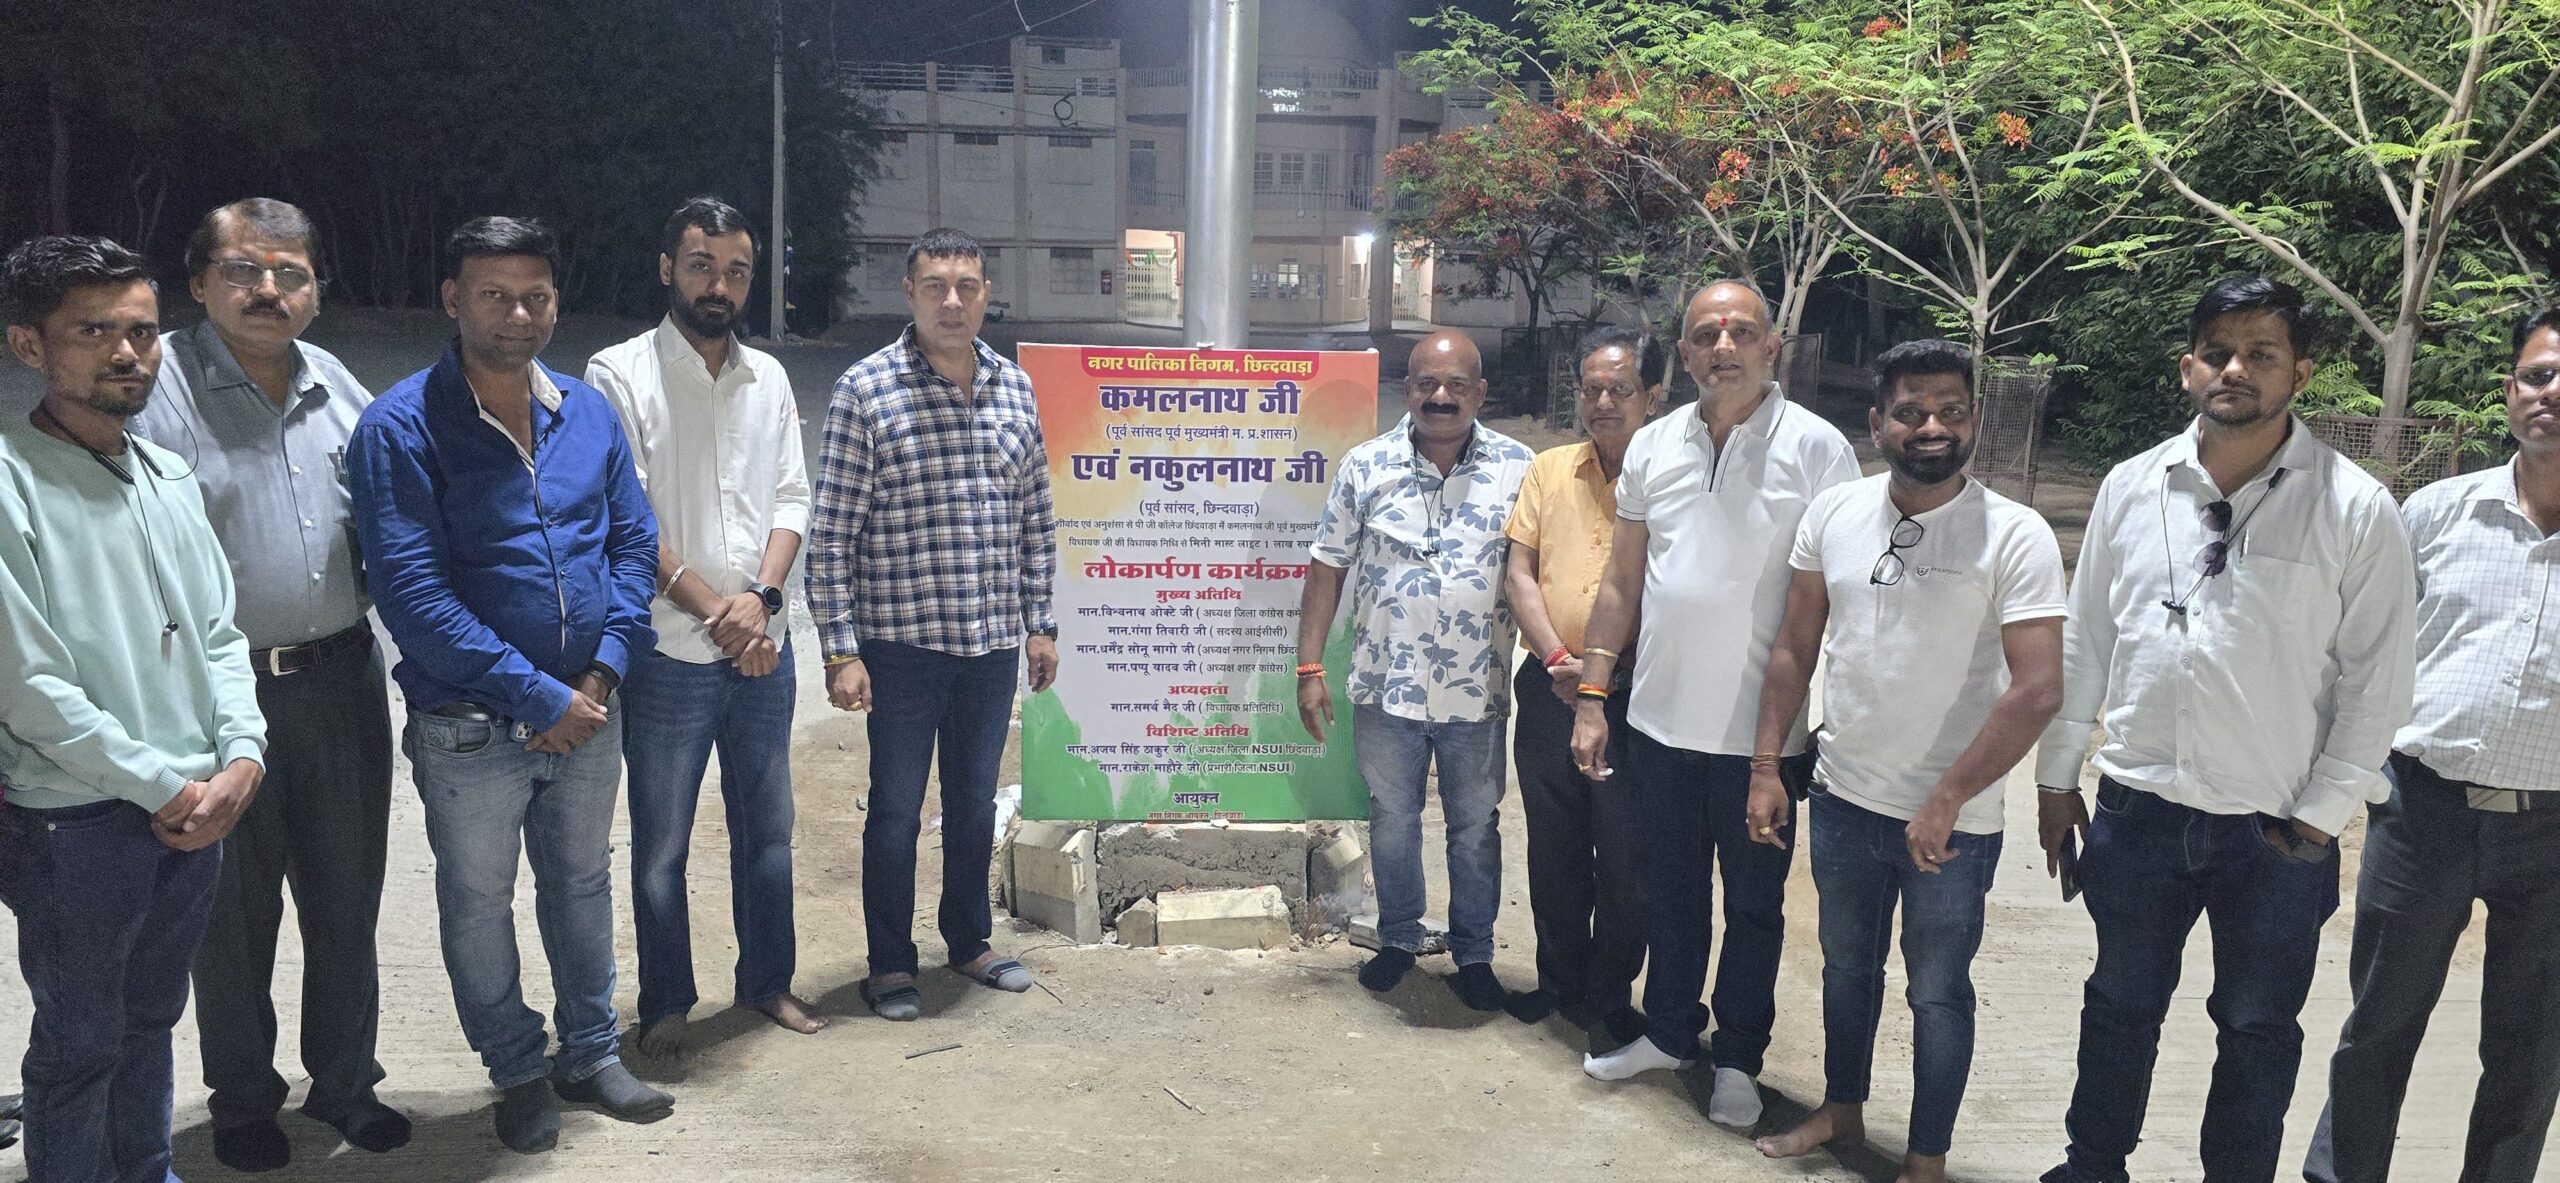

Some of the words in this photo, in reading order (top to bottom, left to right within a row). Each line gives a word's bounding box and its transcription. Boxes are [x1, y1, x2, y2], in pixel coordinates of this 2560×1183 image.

[1088, 356, 1123, 370] नगर
[1127, 353, 1186, 371] पालिका
[1190, 353, 1240, 374] निगम,
[1244, 354, 1312, 376] छिन्दवाड़ा
[1100, 386, 1249, 413] कमलनाथ
[1258, 380, 1301, 414] जी
[1106, 425, 1126, 441] (पूर्व
[1131, 425, 1161, 438] सांसद
[1166, 426, 1181, 441] पूर्व
[1185, 426, 1229, 441] मुख्यमंत्री
[1232, 430, 1244, 440] म.
[1248, 427, 1298, 441] प्र.शासन)
[1071, 449, 1120, 481] एवं
[1128, 456, 1276, 492] नकुलनाथ
[1285, 451, 1328, 484] जी
[1139, 500, 1160, 515] (पूर्व
[1163, 501, 1199, 515] सांसद,
[1203, 501, 1260, 517] छिन्दवाड़ा)
[1055, 518, 1078, 528] शीर्वाद
[1081, 519, 1091, 529] एवं
[1093, 520, 1124, 531] अनुशंसा
[1126, 520, 1133, 529] से
[1135, 520, 1144, 529] पी
[1146, 520, 1155, 529] जी
[1158, 520, 1183, 529] कॉलेज
[1184, 519, 1216, 531] छिंदवाड़ा
[1227, 521, 1262, 530] कमलनाथ
[1264, 521, 1274, 530] जी
[1277, 521, 1287, 532] पूर्व
[1102, 537, 1112, 547] जी
[1115, 537, 1124, 547] की
[1180, 538, 1187, 547] से
[1190, 537, 1211, 547] मिनी
[1238, 540, 1260, 549] लाइट
[1273, 540, 1293, 548] लाख
[1084, 555, 1201, 579] लोकार्पण
[1156, 589, 1190, 603] मुख्य
[1195, 587, 1241, 600] अतिथि
[1150, 605, 1177, 617] ओक्टे
[1180, 605, 1193, 617] जी
[1234, 607, 1256, 618] जिला
[1259, 607, 1283, 618] कांग्रेस
[1108, 624, 1152, 635] मान.गंगा
[1156, 623, 1189, 636] तिवारी
[1193, 623, 1207, 635] जी
[1128, 642, 1150, 658] सोनू
[1153, 642, 1177, 654] मागो
[1181, 642, 1195, 654] जी
[1233, 646, 1251, 654] नगर
[1253, 644, 1275, 654] निगम
[1107, 663, 1150, 676] मान.पप्पू
[1153, 662, 1179, 672] यादव
[1183, 660, 1196, 672] जी
[1237, 664, 1255, 673] शहर
[1258, 663, 1288, 674] कांग्रेस)
[1168, 685, 1228, 695] अध्यक्षता
[1110, 699, 1158, 712] मान.समर्थ
[1163, 698, 1178, 712] मैद
[1182, 700, 1196, 712] जी
[1146, 724, 1199, 736] विशिष्ट
[1202, 724, 1249, 737] अतिथि
[1067, 745, 1117, 754] मान.अजय
[1120, 742, 1140, 754] सिंह
[1143, 745, 1169, 758] ठाकुर
[1173, 743, 1186, 754] जी
[1227, 744, 1249, 754] जिला
[1252, 745, 1282, 754] NSUI
[1099, 761, 1150, 772] मान.राकेश
[1154, 759, 1182, 773] माहौरे
[1187, 760, 1200, 772] जी
[1203, 762, 1231, 774] (प्रभारी
[1235, 762, 1256, 772] जिला
[1259, 762, 1295, 774] NSUI)
[1174, 793, 1220, 808] आयुक्त
